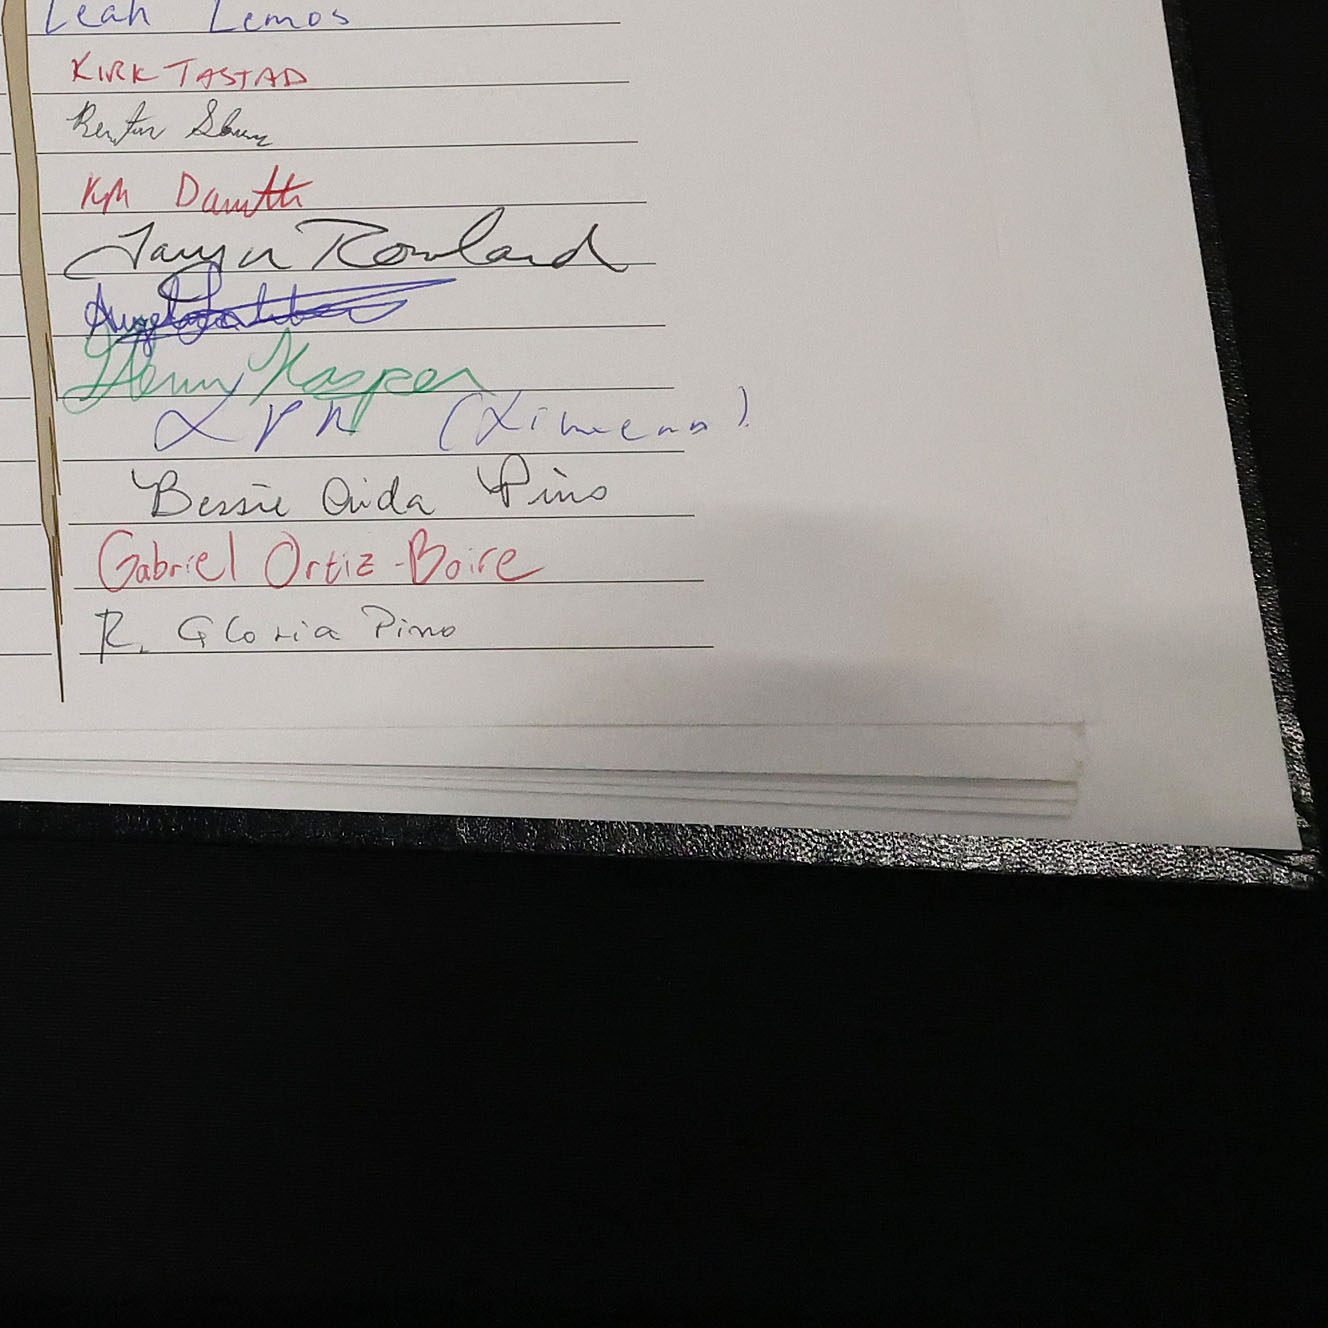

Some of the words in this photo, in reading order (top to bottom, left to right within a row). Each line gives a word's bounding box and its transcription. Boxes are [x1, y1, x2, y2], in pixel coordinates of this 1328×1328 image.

[69, 50, 153, 84] KIRK
[162, 56, 310, 89] TASTAD
[97, 529, 237, 592] Gabriel
